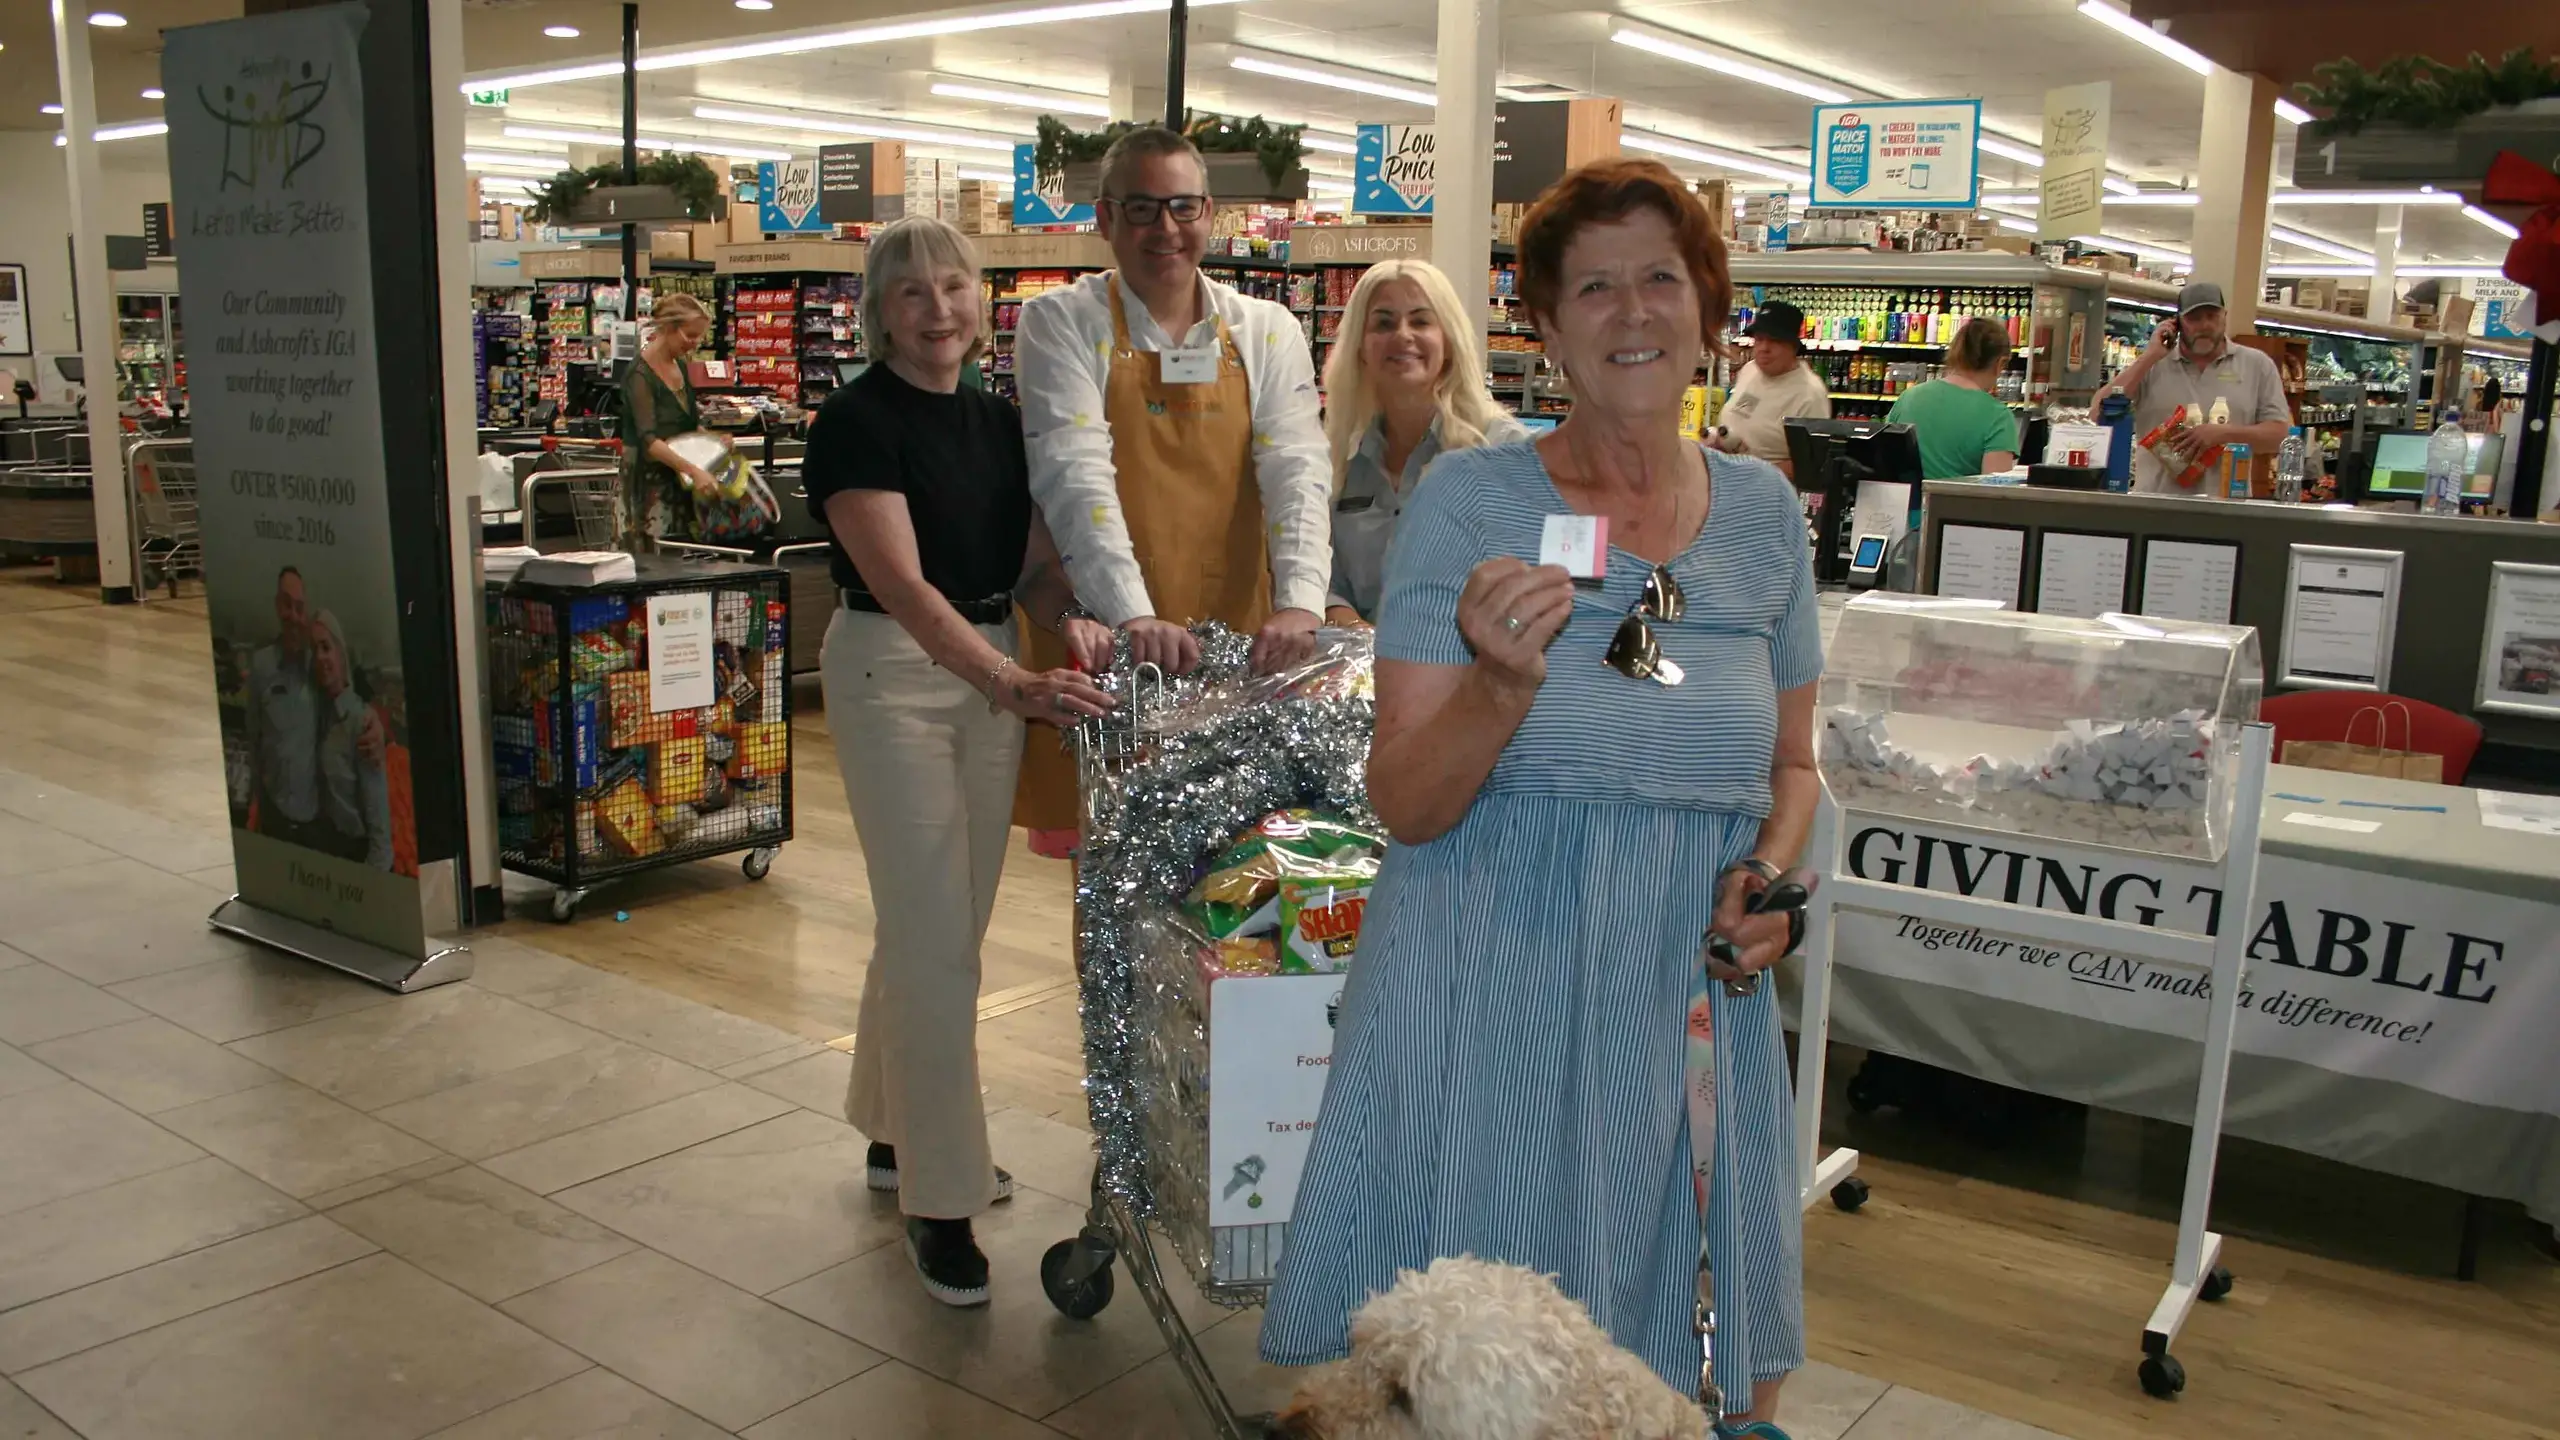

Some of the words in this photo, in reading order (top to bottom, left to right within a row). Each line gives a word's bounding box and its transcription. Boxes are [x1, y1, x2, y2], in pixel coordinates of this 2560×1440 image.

[1841, 116, 1859, 127] IGA
[1889, 123, 1915, 132] CHECKED
[1832, 130, 1867, 144] PRICE
[1888, 134, 1915, 144] MATCHED
[1832, 143, 1864, 154] MATCH
[1880, 148, 1891, 157] YOU
[1911, 147, 1923, 157] PAY
[1923, 146, 1941, 156] MORE
[2318, 141, 2337, 175] 1
[783, 163, 809, 185] Low
[777, 185, 815, 207] Prices
[1343, 237, 1417, 252] ASHCROFTS
[764, 253, 790, 262] BRANDS
[2475, 289, 2498, 297] MILK
[2500, 289, 2519, 297] AND
[222, 290, 252, 316] Our
[255, 289, 347, 323] Community
[216, 327, 245, 355] and
[246, 327, 322, 361] Ashcroft's
[325, 328, 355, 356] IGA
[226, 367, 286, 403] working
[290, 369, 354, 403] together
[249, 408, 264, 433] to
[266, 407, 284, 434] do
[286, 409, 333, 442] good!
[230, 469, 278, 499] OVER
[280, 473, 356, 508] $500,000
[254, 511, 294, 541] since
[296, 516, 336, 546] 2016
[288, 860, 332, 892] Thank
[1848, 827, 2164, 927] GIVING
[1896, 914, 2013, 957] Together
[2018, 943, 2060, 968] we
[2067, 951, 2144, 986] CAN
[2144, 971, 2213, 1001] mak
[2237, 990, 2255, 1009] a
[2260, 989, 2433, 1044] difference!
[1296, 1053, 1332, 1067] Food
[1266, 1121, 1292, 1133] Tax
